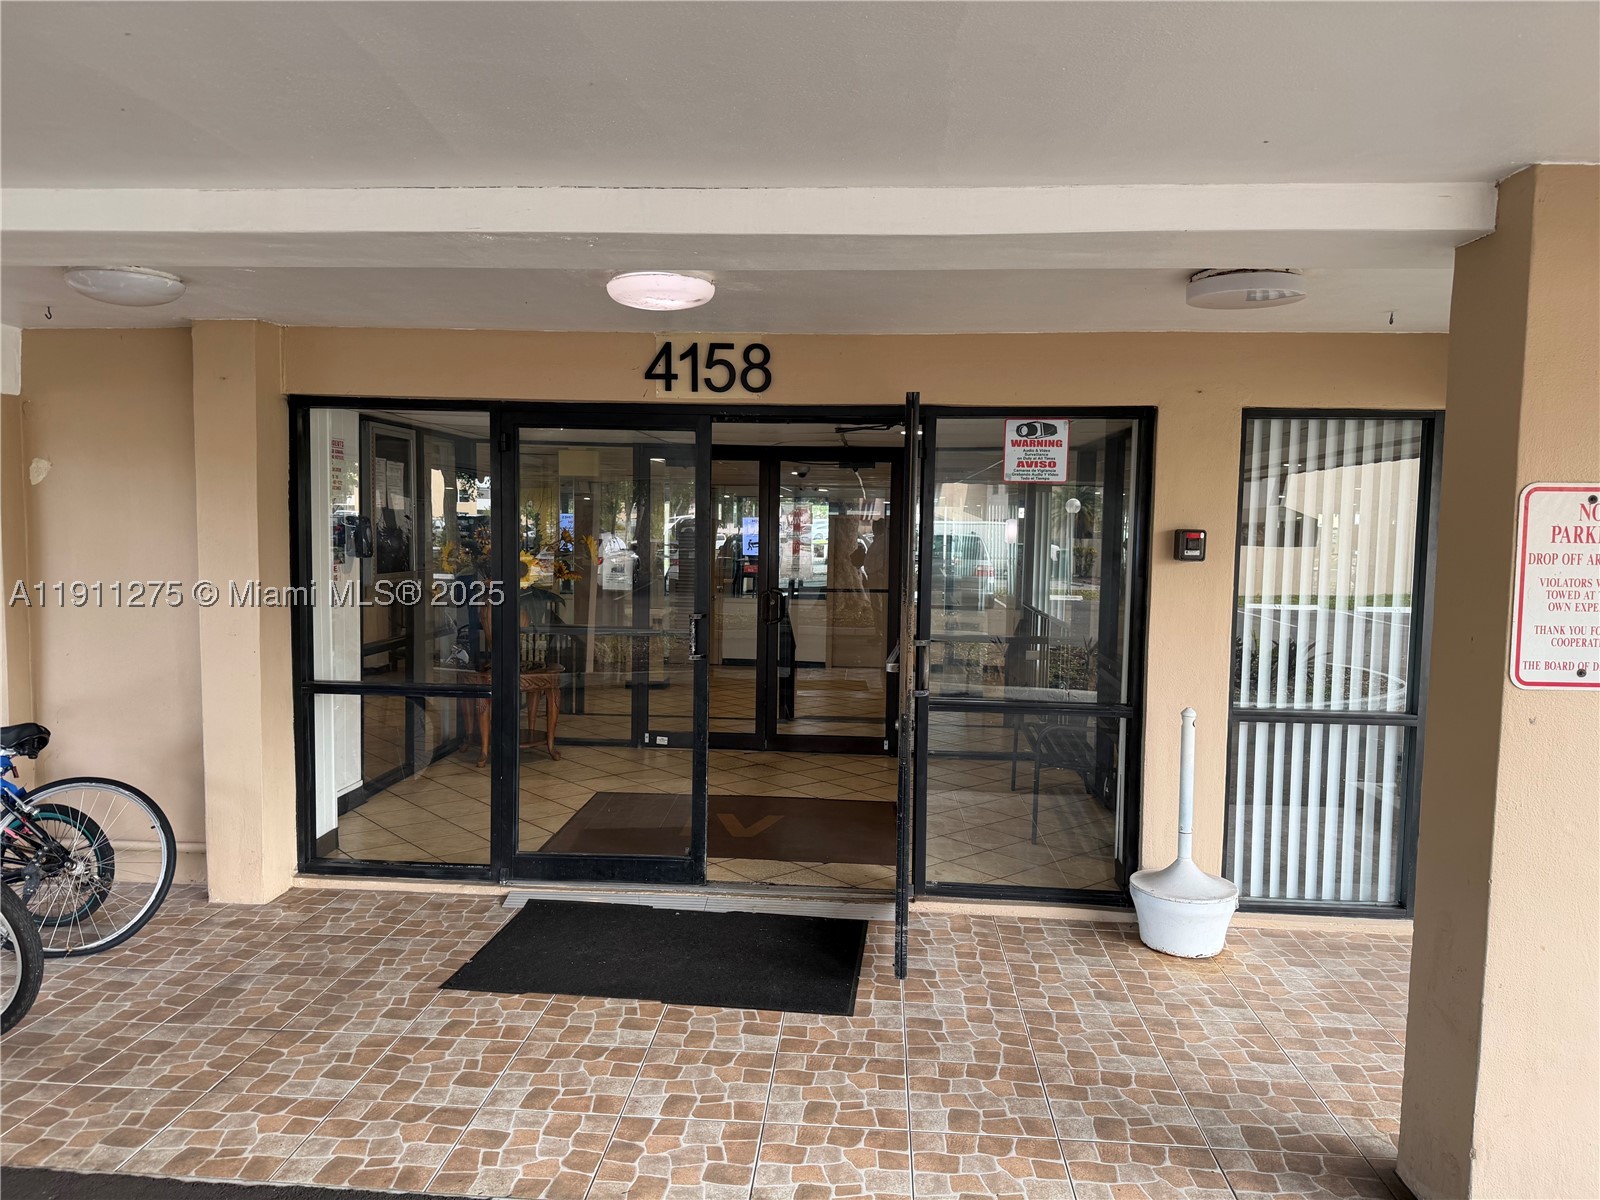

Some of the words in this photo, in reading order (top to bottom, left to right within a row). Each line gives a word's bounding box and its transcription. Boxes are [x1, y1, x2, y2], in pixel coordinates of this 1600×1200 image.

[645, 342, 771, 393] 4158
[1010, 439, 1063, 448] WARNING
[1016, 460, 1057, 468] AVISO
[1550, 525, 1600, 544] PARK
[1528, 553, 1559, 565] DROP
[1561, 553, 1584, 566] OFF
[1539, 578, 1593, 588] VIOLATORS
[1546, 590, 1581, 600] TOWED
[1583, 590, 1596, 600] AT
[1547, 602, 1571, 612] OWN
[1575, 603, 1600, 613] EXPE
[1534, 625, 1566, 635] THANK
[1569, 625, 1587, 636] YOU
[1523, 661, 1541, 670] THE
[1544, 661, 1575, 671] BOARD
[1577, 662, 1590, 671] OF
